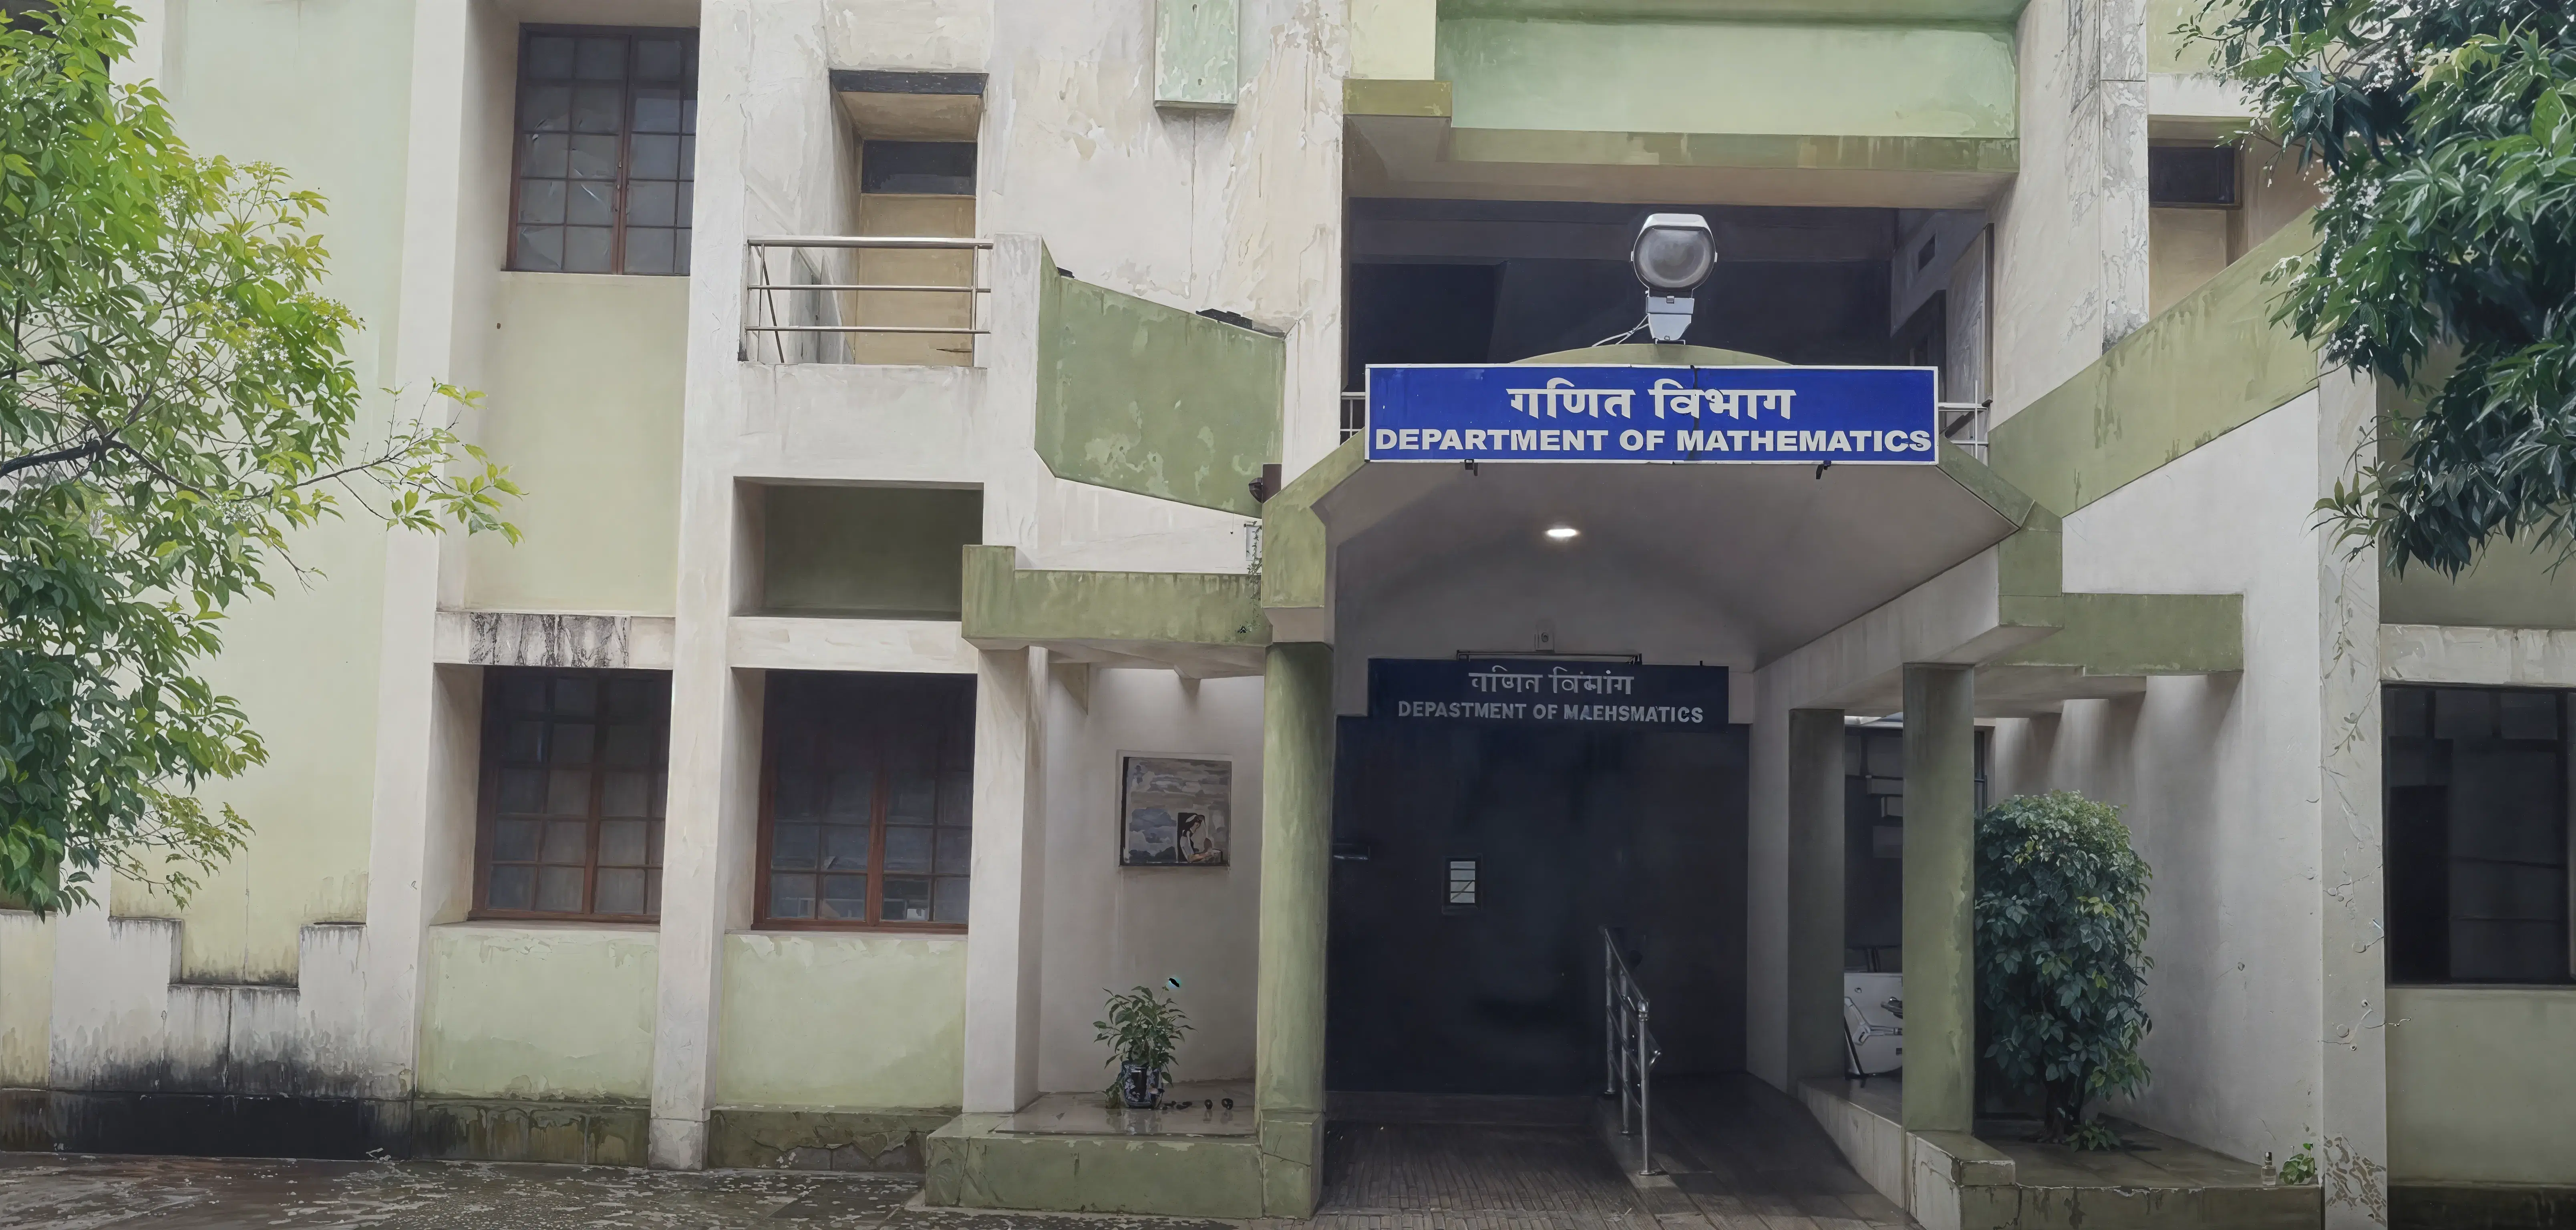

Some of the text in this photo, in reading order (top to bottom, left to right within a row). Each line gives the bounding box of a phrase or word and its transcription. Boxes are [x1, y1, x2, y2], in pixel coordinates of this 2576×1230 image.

[1506, 378, 1797, 420] गणित विभाग
[1376, 429, 1931, 452] DEPARTMENT OF MATHEMATICS
[1533, 704, 1558, 719] OF
